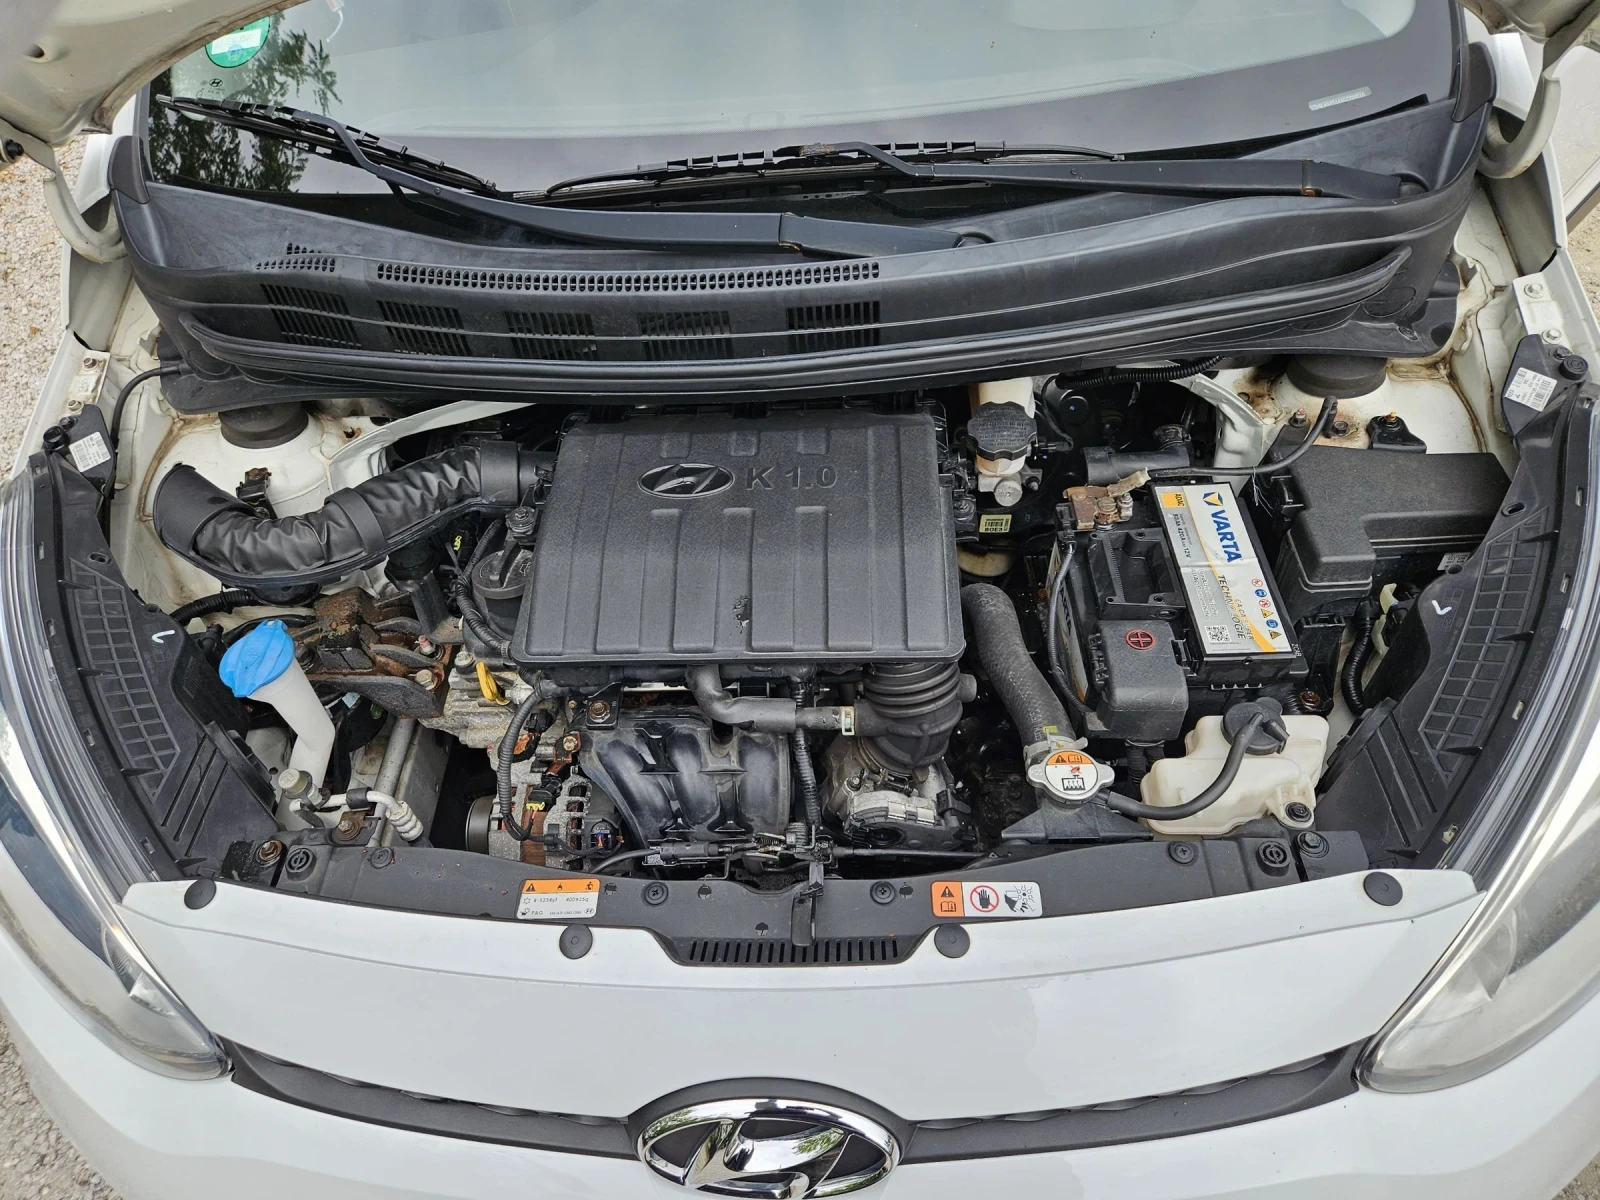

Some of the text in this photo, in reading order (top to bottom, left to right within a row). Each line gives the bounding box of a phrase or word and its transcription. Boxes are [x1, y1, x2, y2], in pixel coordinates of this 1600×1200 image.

[746, 465, 838, 491] K 1.0
[1211, 509, 1242, 563] VARTA
